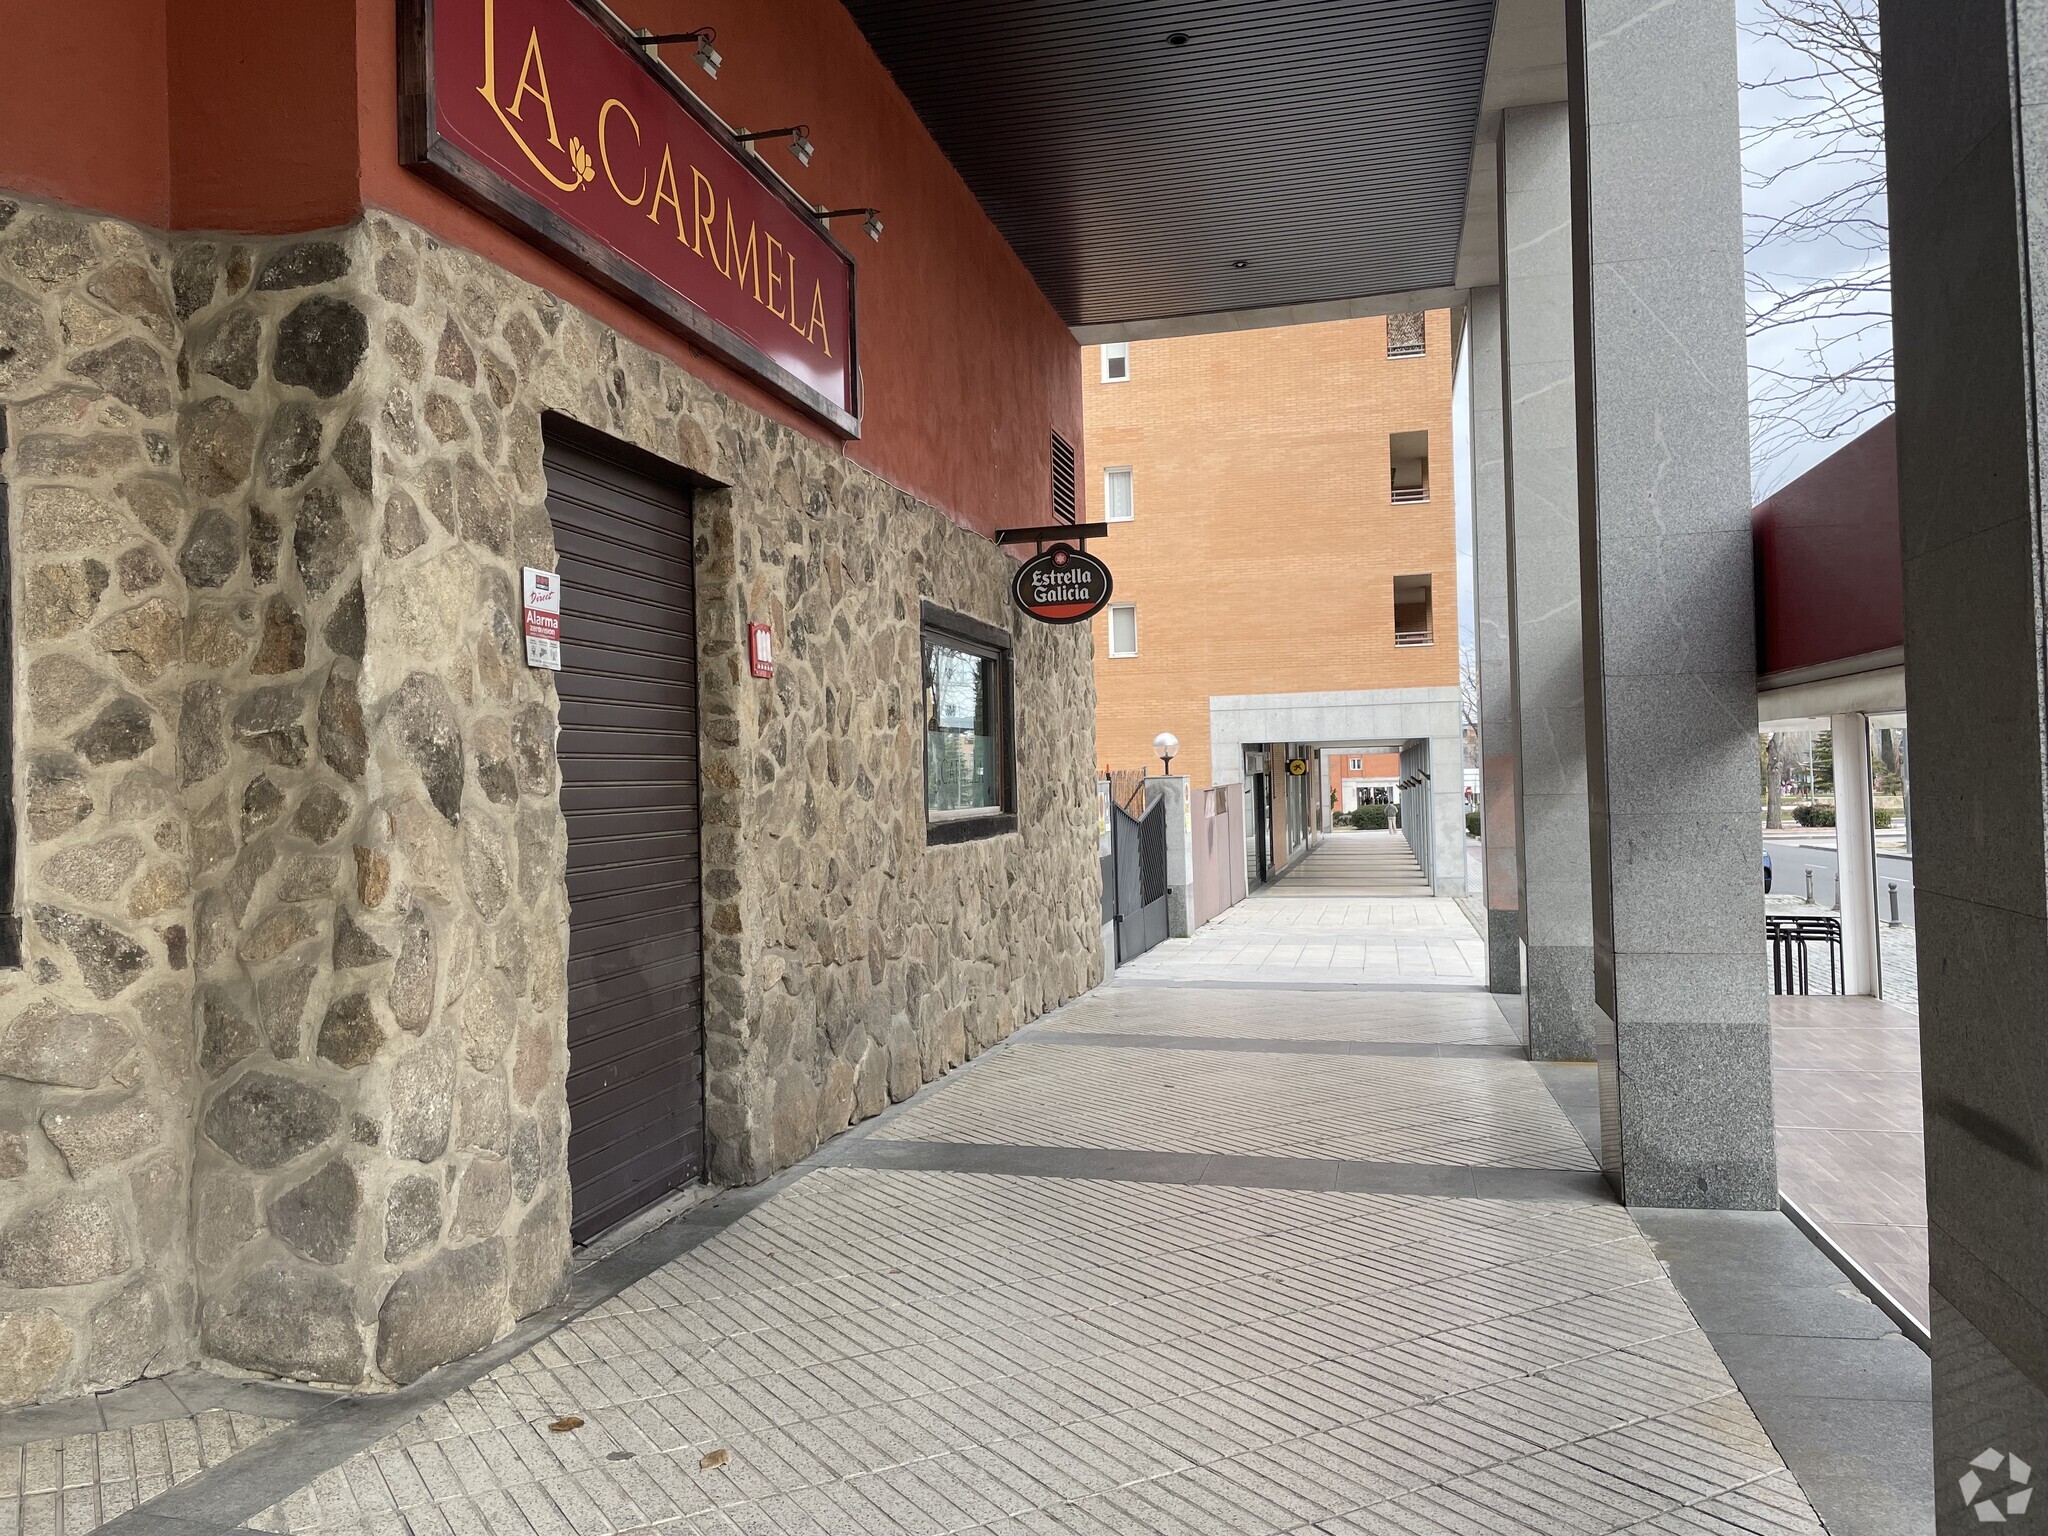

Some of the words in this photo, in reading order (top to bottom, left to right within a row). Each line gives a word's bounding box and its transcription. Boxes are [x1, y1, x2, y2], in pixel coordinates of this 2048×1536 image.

[598, 98, 833, 358] CARMELA
[1031, 568, 1092, 586] Estrella
[530, 590, 555, 604] Direct
[1033, 584, 1090, 603] Galicia
[526, 610, 559, 628] Alarma
